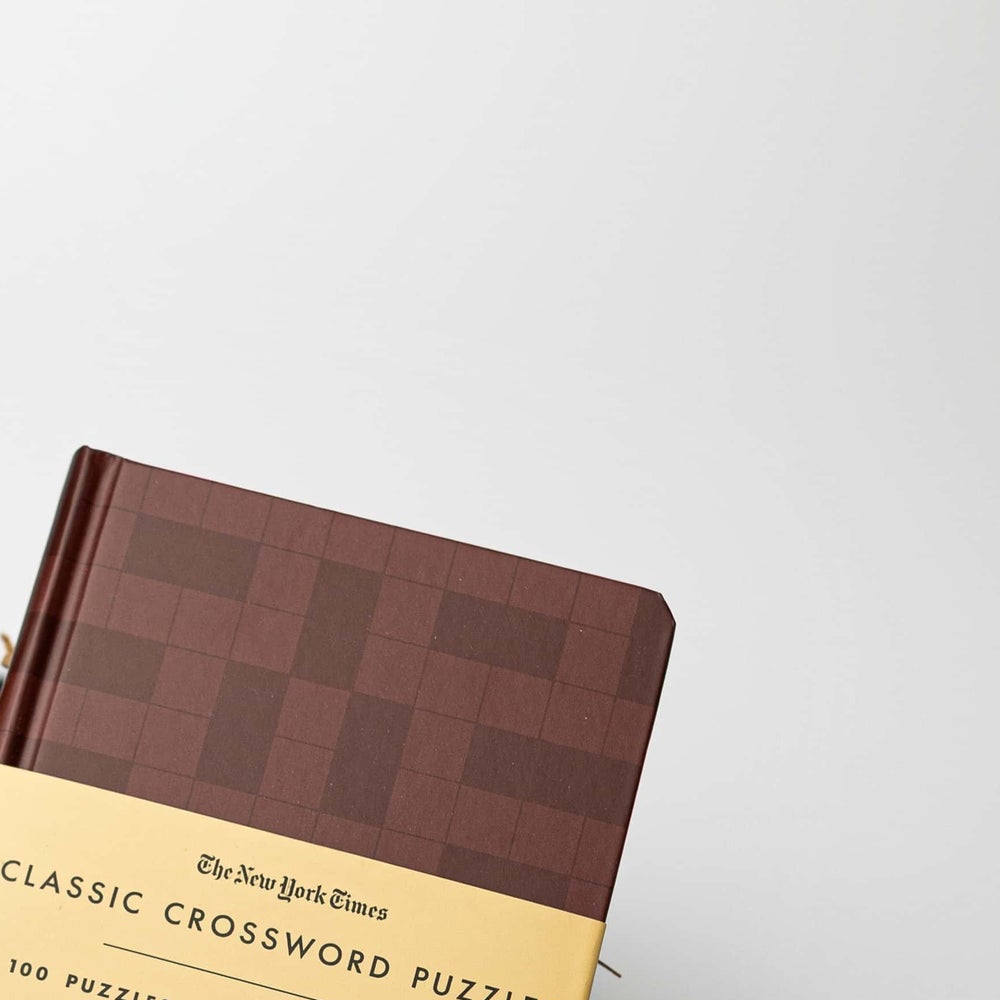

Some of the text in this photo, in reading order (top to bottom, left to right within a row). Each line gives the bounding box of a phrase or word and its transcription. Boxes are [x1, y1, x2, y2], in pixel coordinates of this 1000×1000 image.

[1, 860, 143, 914] CLASSIC
[164, 902, 390, 978] CROSSWORD
[197, 854, 388, 921] The New York Times
[10, 959, 48, 981] 100
